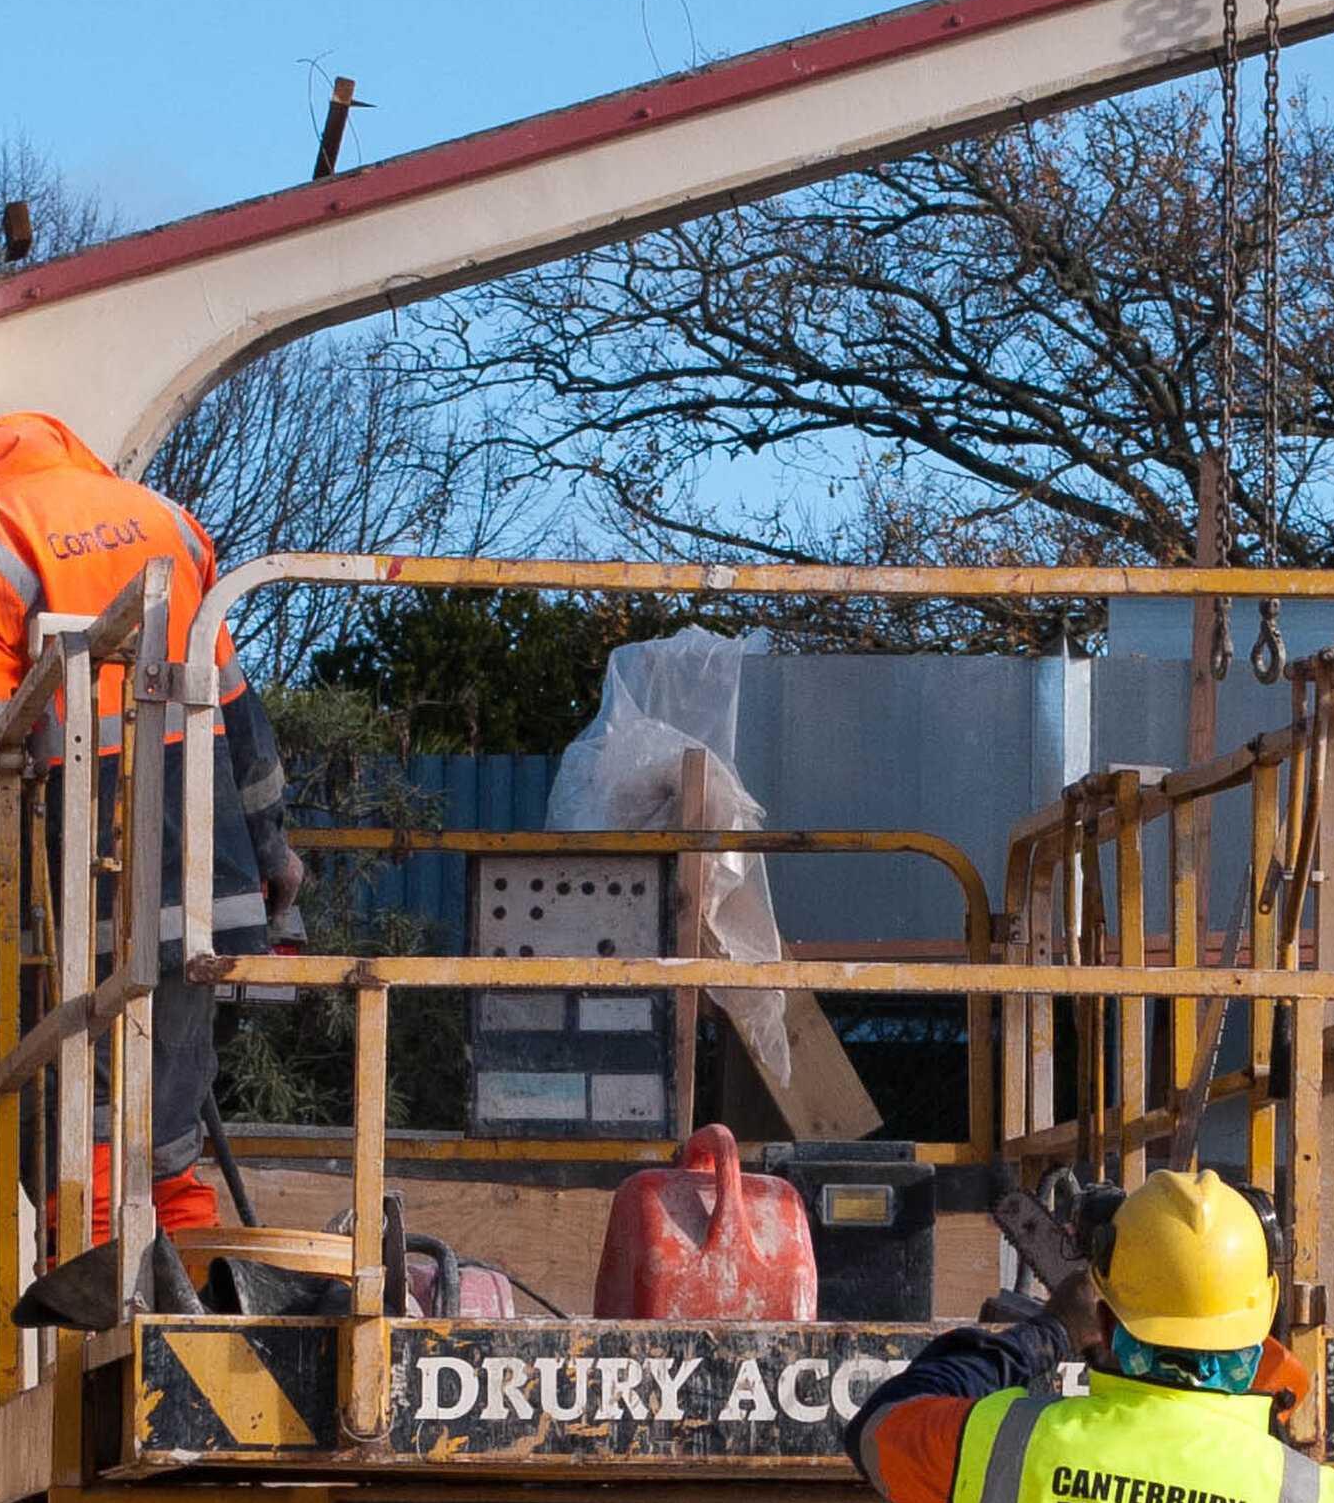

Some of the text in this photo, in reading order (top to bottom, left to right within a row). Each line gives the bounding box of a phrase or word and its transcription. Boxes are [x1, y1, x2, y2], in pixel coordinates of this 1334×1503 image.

[48, 519, 147, 559] ConCut
[414, 1357, 912, 1422] DRURY ACC
